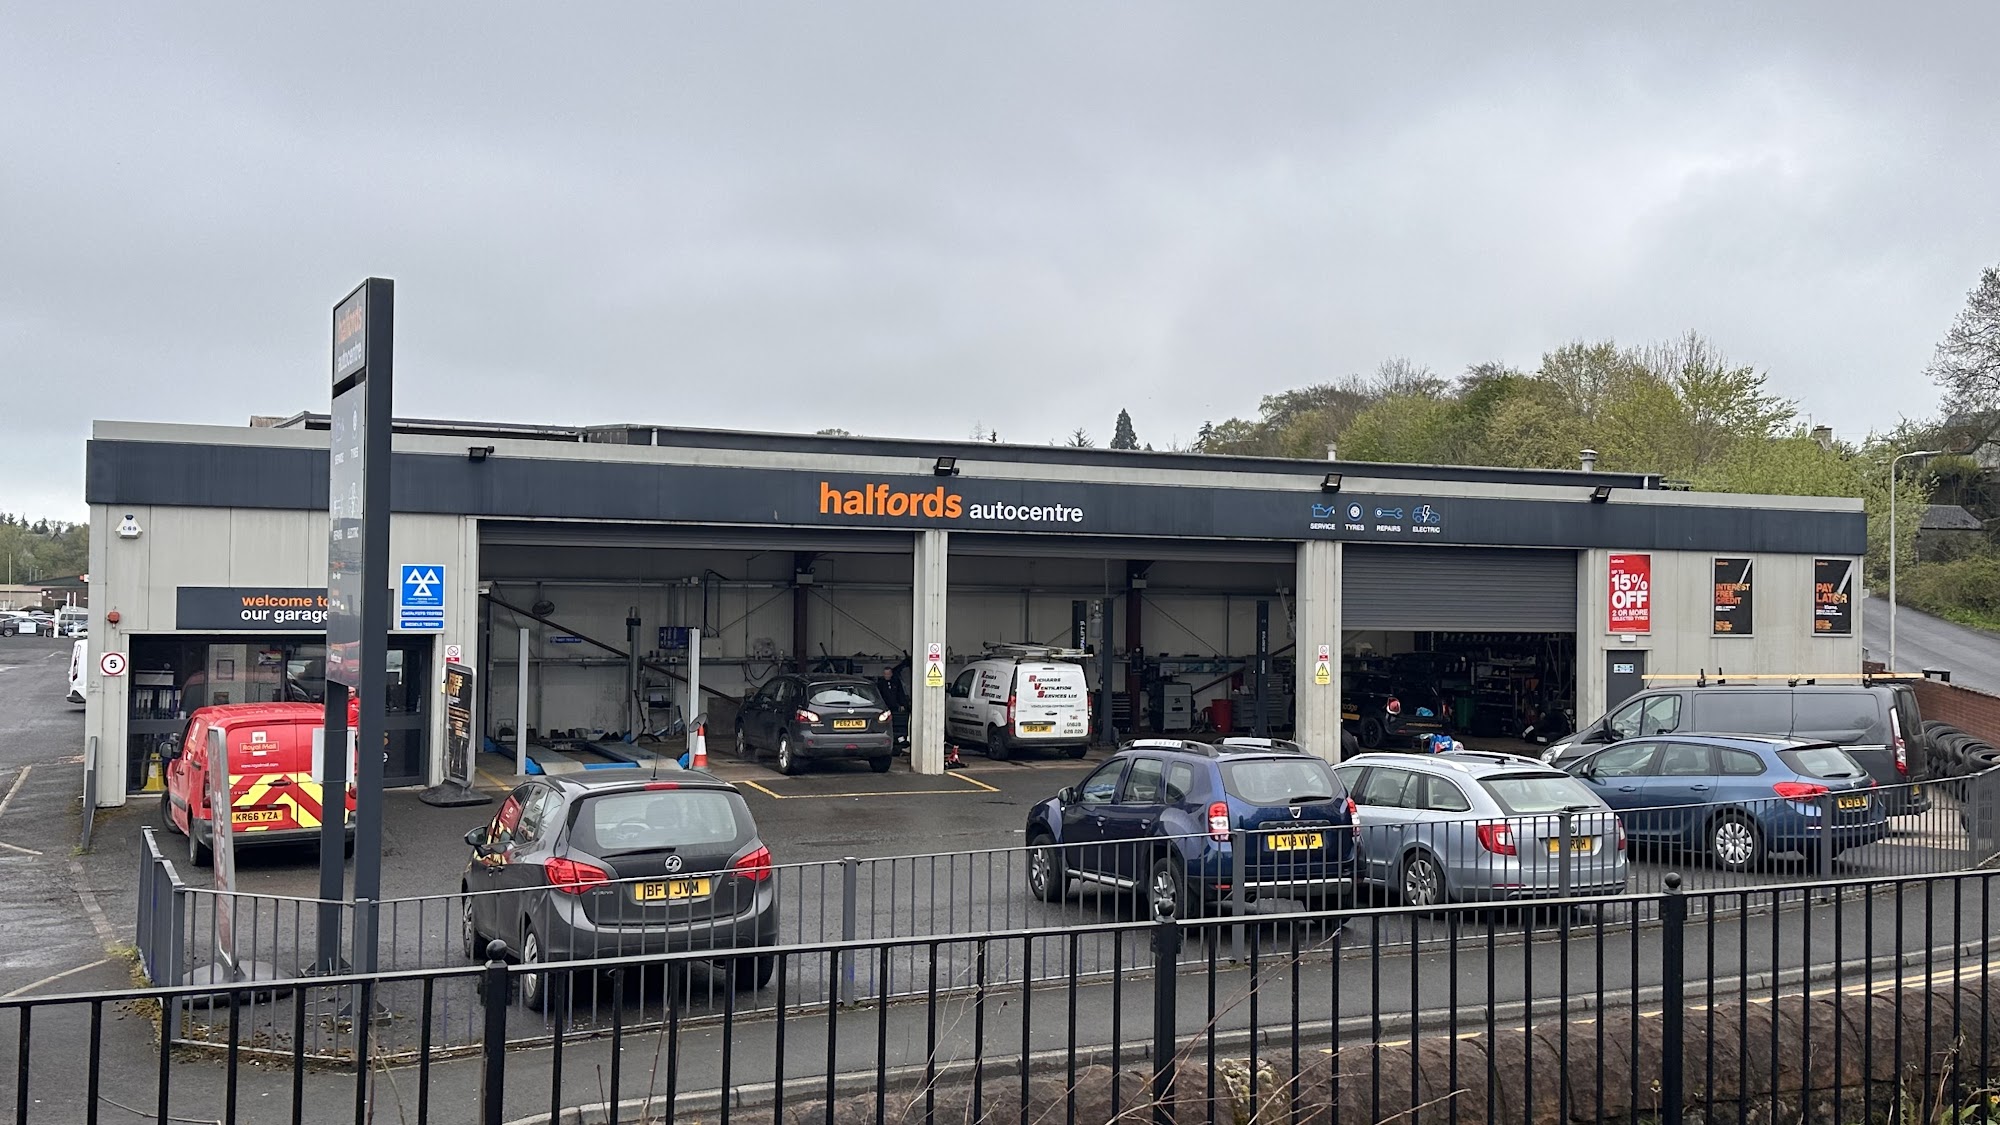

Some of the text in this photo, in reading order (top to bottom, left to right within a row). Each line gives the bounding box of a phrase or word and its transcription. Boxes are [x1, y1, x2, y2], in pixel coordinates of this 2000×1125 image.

[819, 481, 1083, 522] halfords autocentre
[1310, 522, 1336, 530] SERVICE
[1345, 523, 1365, 531] TYRES
[1376, 524, 1401, 532] REPAIRS
[1412, 525, 1440, 533] ELECTRIC
[1611, 573, 1648, 591] 15%
[1715, 583, 1751, 591] INTEREST
[1816, 583, 1834, 592] PAY
[1715, 590, 1734, 598] FREE
[1816, 592, 1848, 604] LATER
[242, 594, 313, 607] welcome
[1611, 590, 1648, 609] OFF
[1715, 597, 1742, 605] CREDIT
[241, 608, 328, 623] our garage
[1617, 609, 1628, 617] OR
[109, 659, 117, 669] 5
[242, 742, 261, 751] Royal
[235, 811, 279, 821] KR66 YZA
[674, 881, 699, 894] JVM
